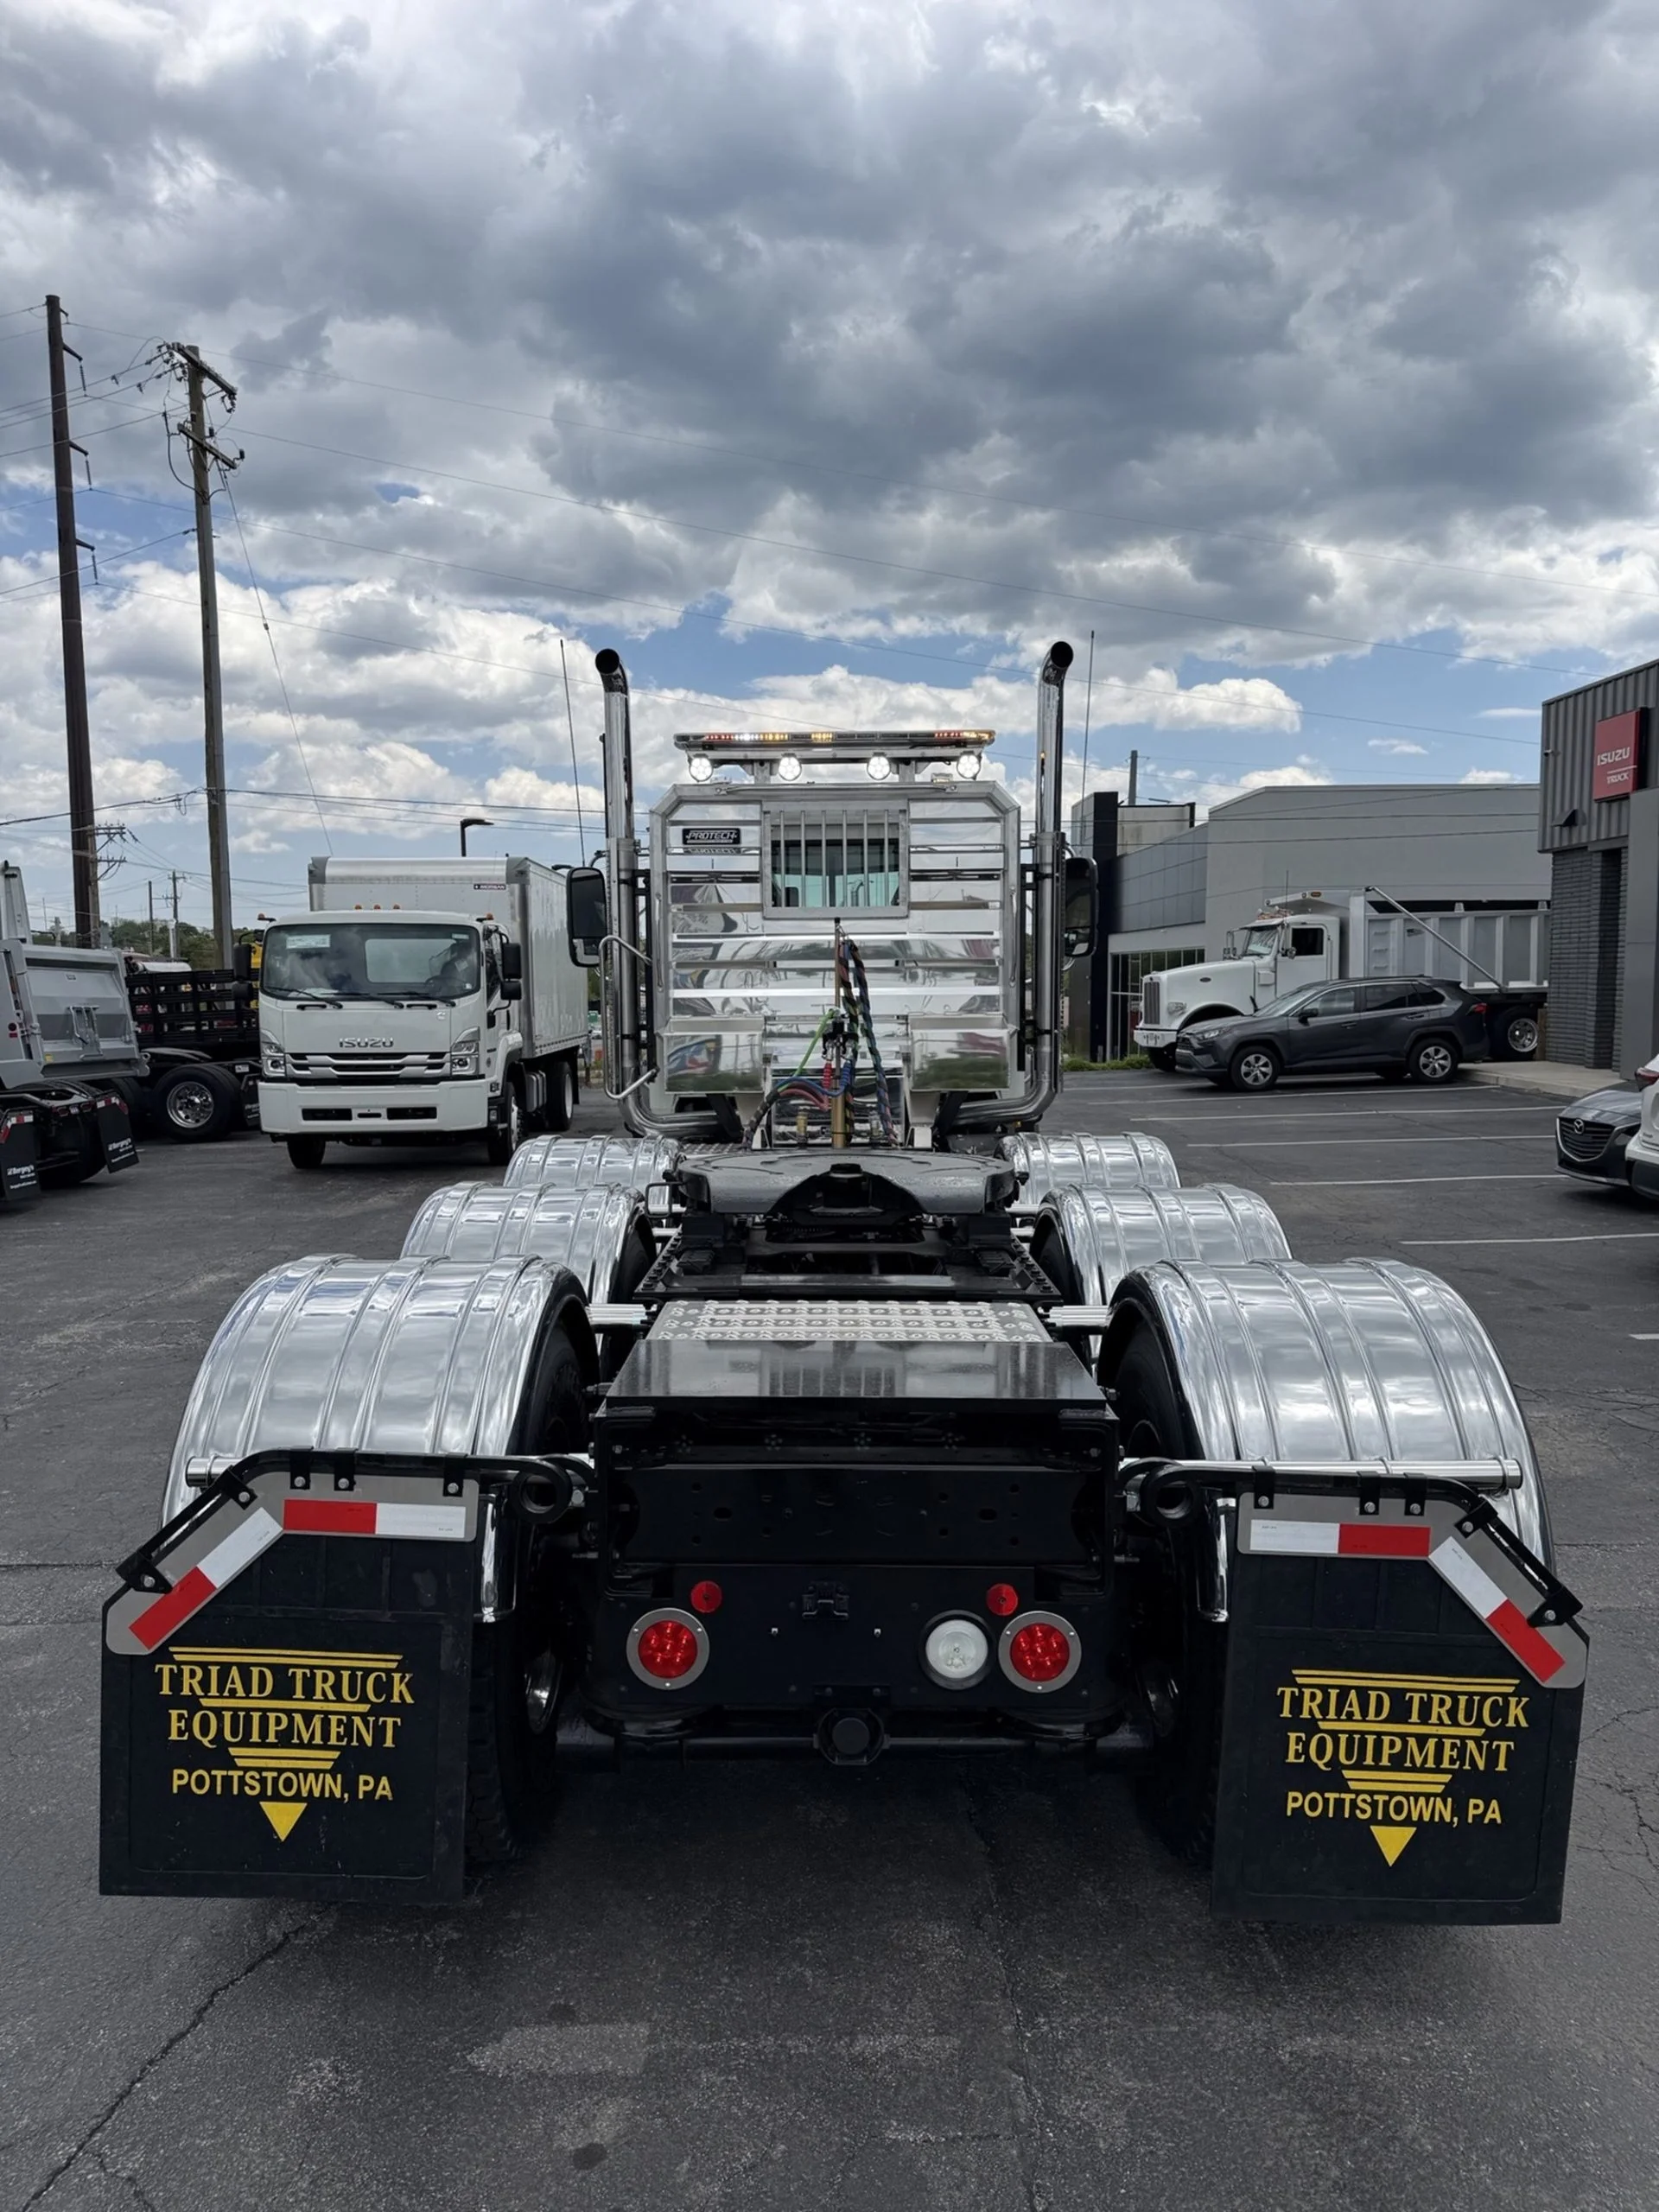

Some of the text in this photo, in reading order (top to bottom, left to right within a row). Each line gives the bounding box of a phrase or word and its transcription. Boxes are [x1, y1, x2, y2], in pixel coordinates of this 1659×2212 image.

[1597, 747, 1630, 766] ISUZU
[1606, 772, 1630, 785] TRUCK
[687, 831, 737, 840] PROTECH
[340, 1037, 394, 1048] ISUZU
[155, 1664, 414, 1704] TRIAD TRUCK
[1277, 1688, 1529, 1728] TRIAD TRUCK
[168, 1709, 401, 1749] EQUIPMENT
[1285, 1732, 1515, 1772] EQUIPMENT
[172, 1769, 393, 1802] POTTSTOWN, PA
[1287, 1791, 1502, 1827] POTTSTOWN, PA
